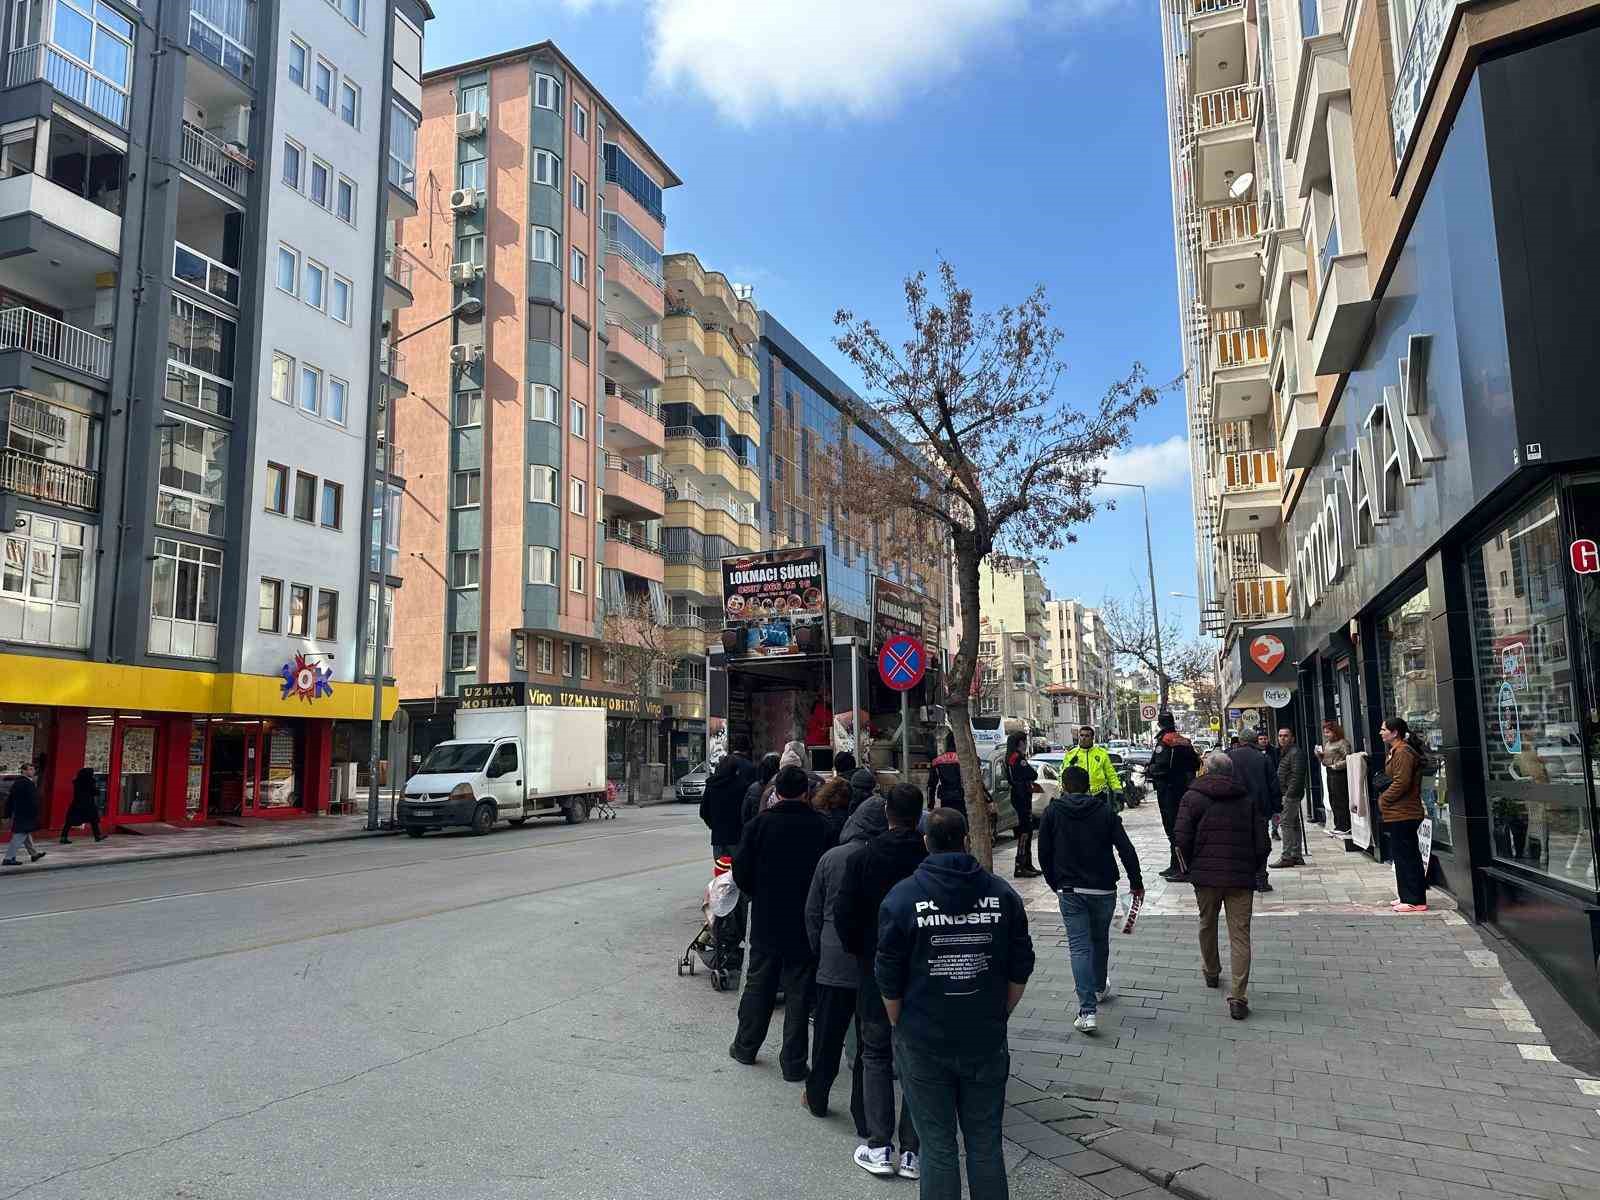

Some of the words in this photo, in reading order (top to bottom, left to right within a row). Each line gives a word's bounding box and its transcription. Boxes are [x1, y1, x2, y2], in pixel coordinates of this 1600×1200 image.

[1332, 334, 1447, 551] YATAK
[729, 567, 778, 585] LOKMACI
[779, 561, 818, 582] ŞÜKRÜ
[463, 685, 515, 697] UZMAN
[560, 692, 598, 707] UZMAN
[916, 912, 1002, 928] MINDSET
